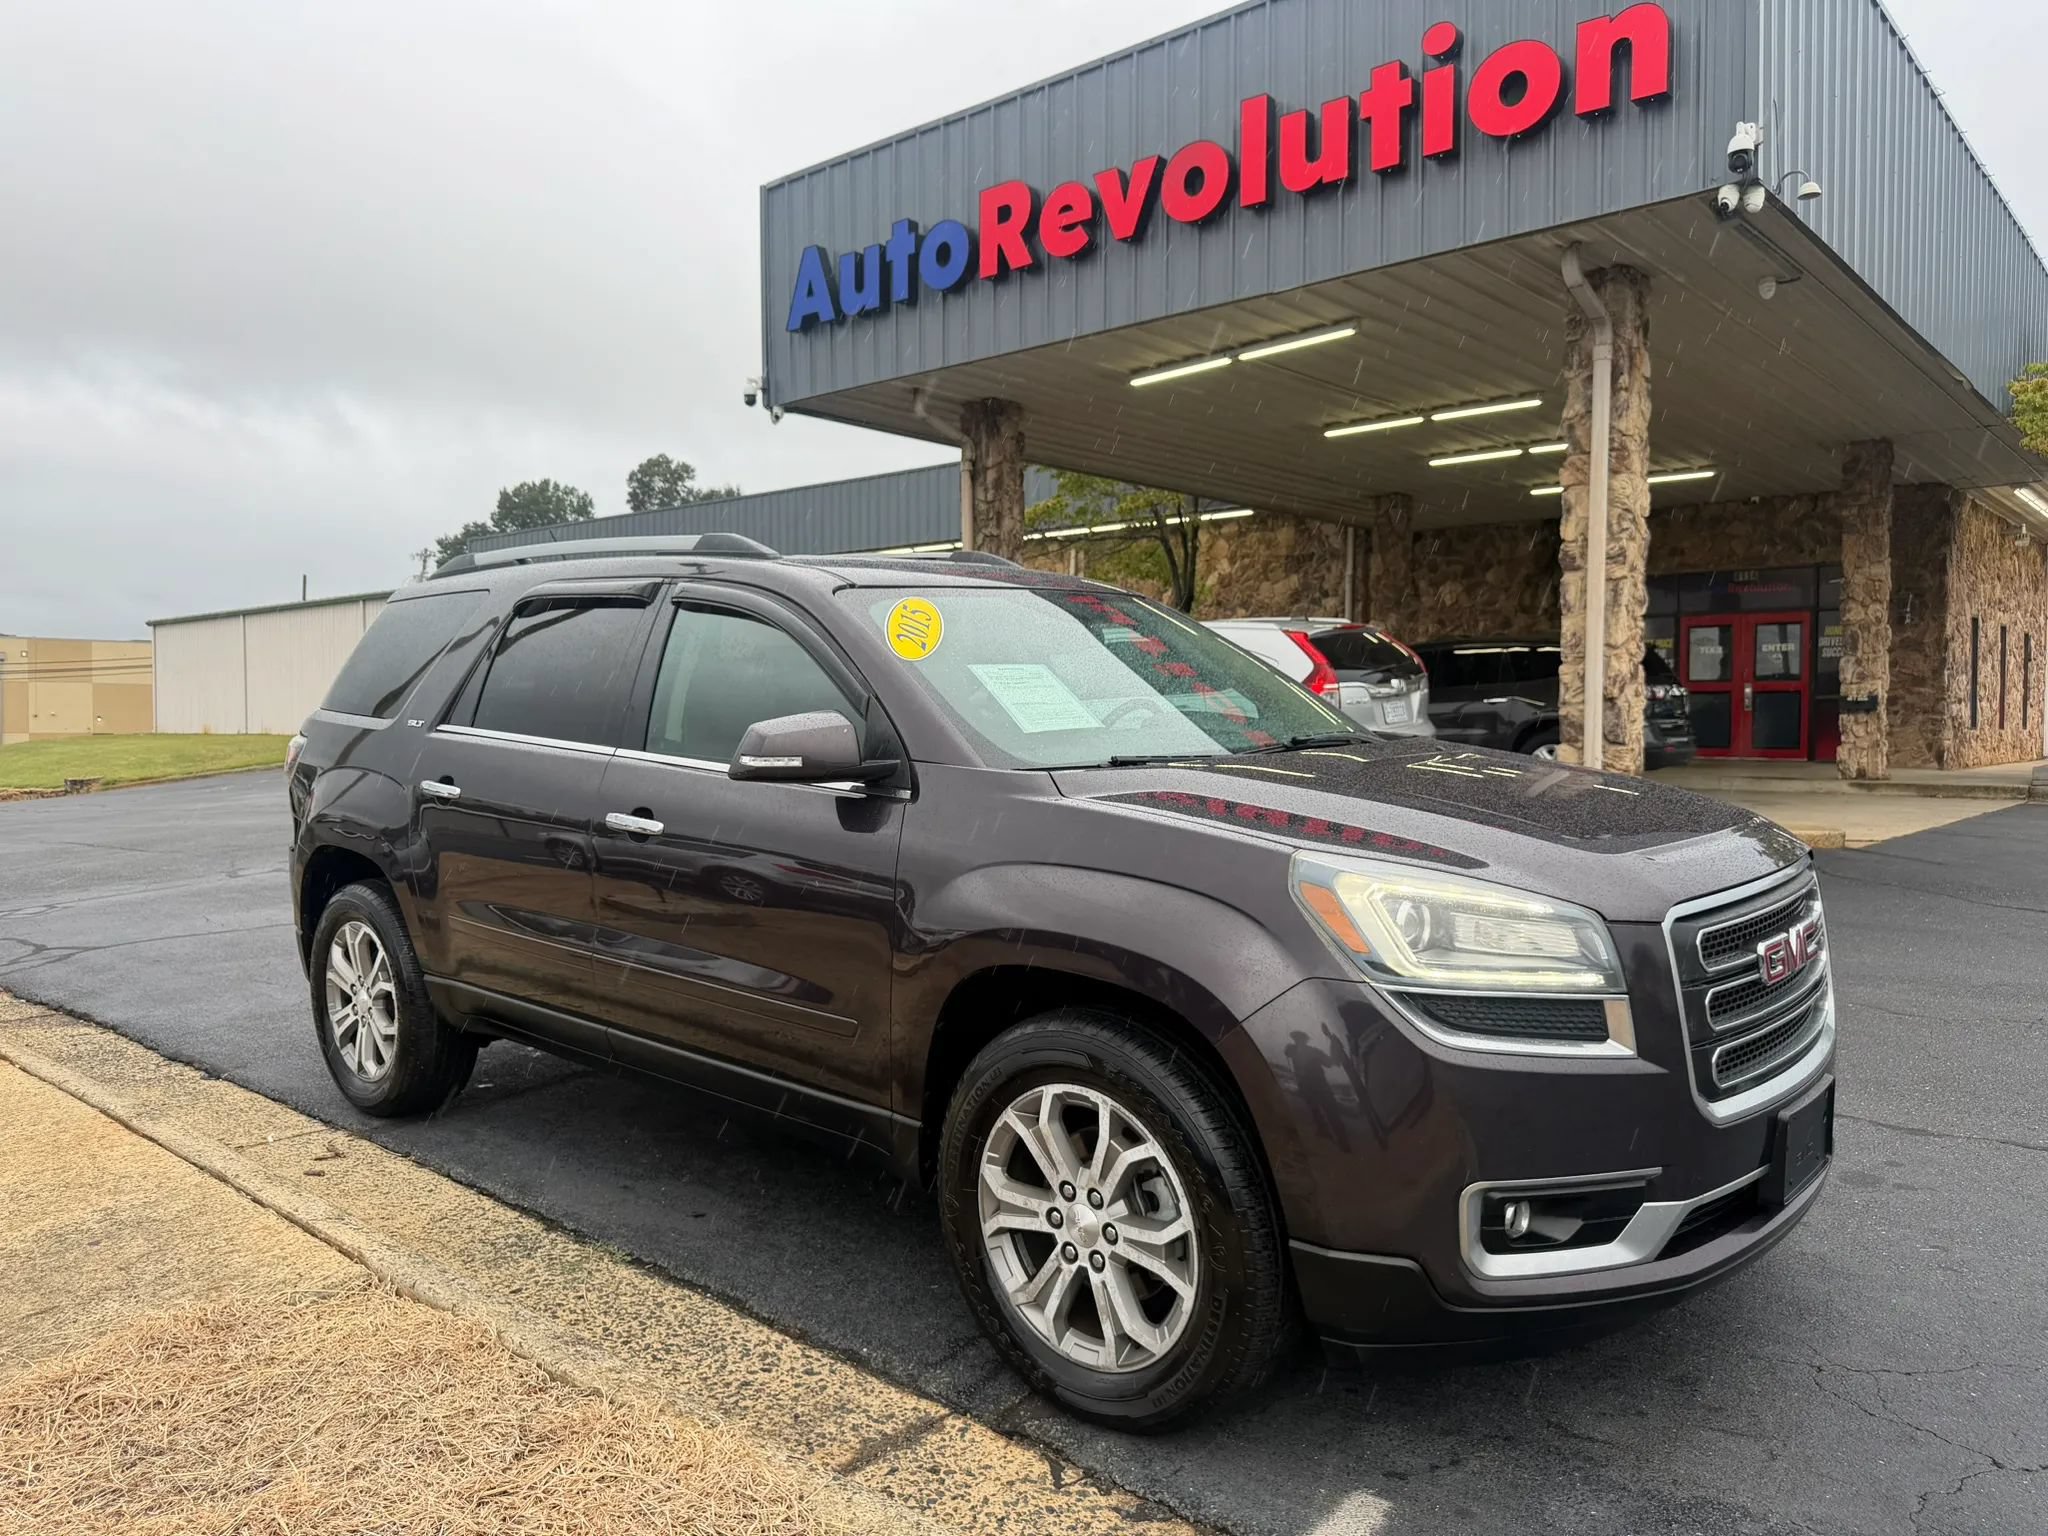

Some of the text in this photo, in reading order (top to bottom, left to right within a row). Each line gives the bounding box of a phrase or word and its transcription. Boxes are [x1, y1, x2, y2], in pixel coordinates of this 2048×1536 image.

[896, 603, 931, 652] 2015
[1761, 643, 1796, 653] ENTER
[1758, 918, 1820, 986] GMC
